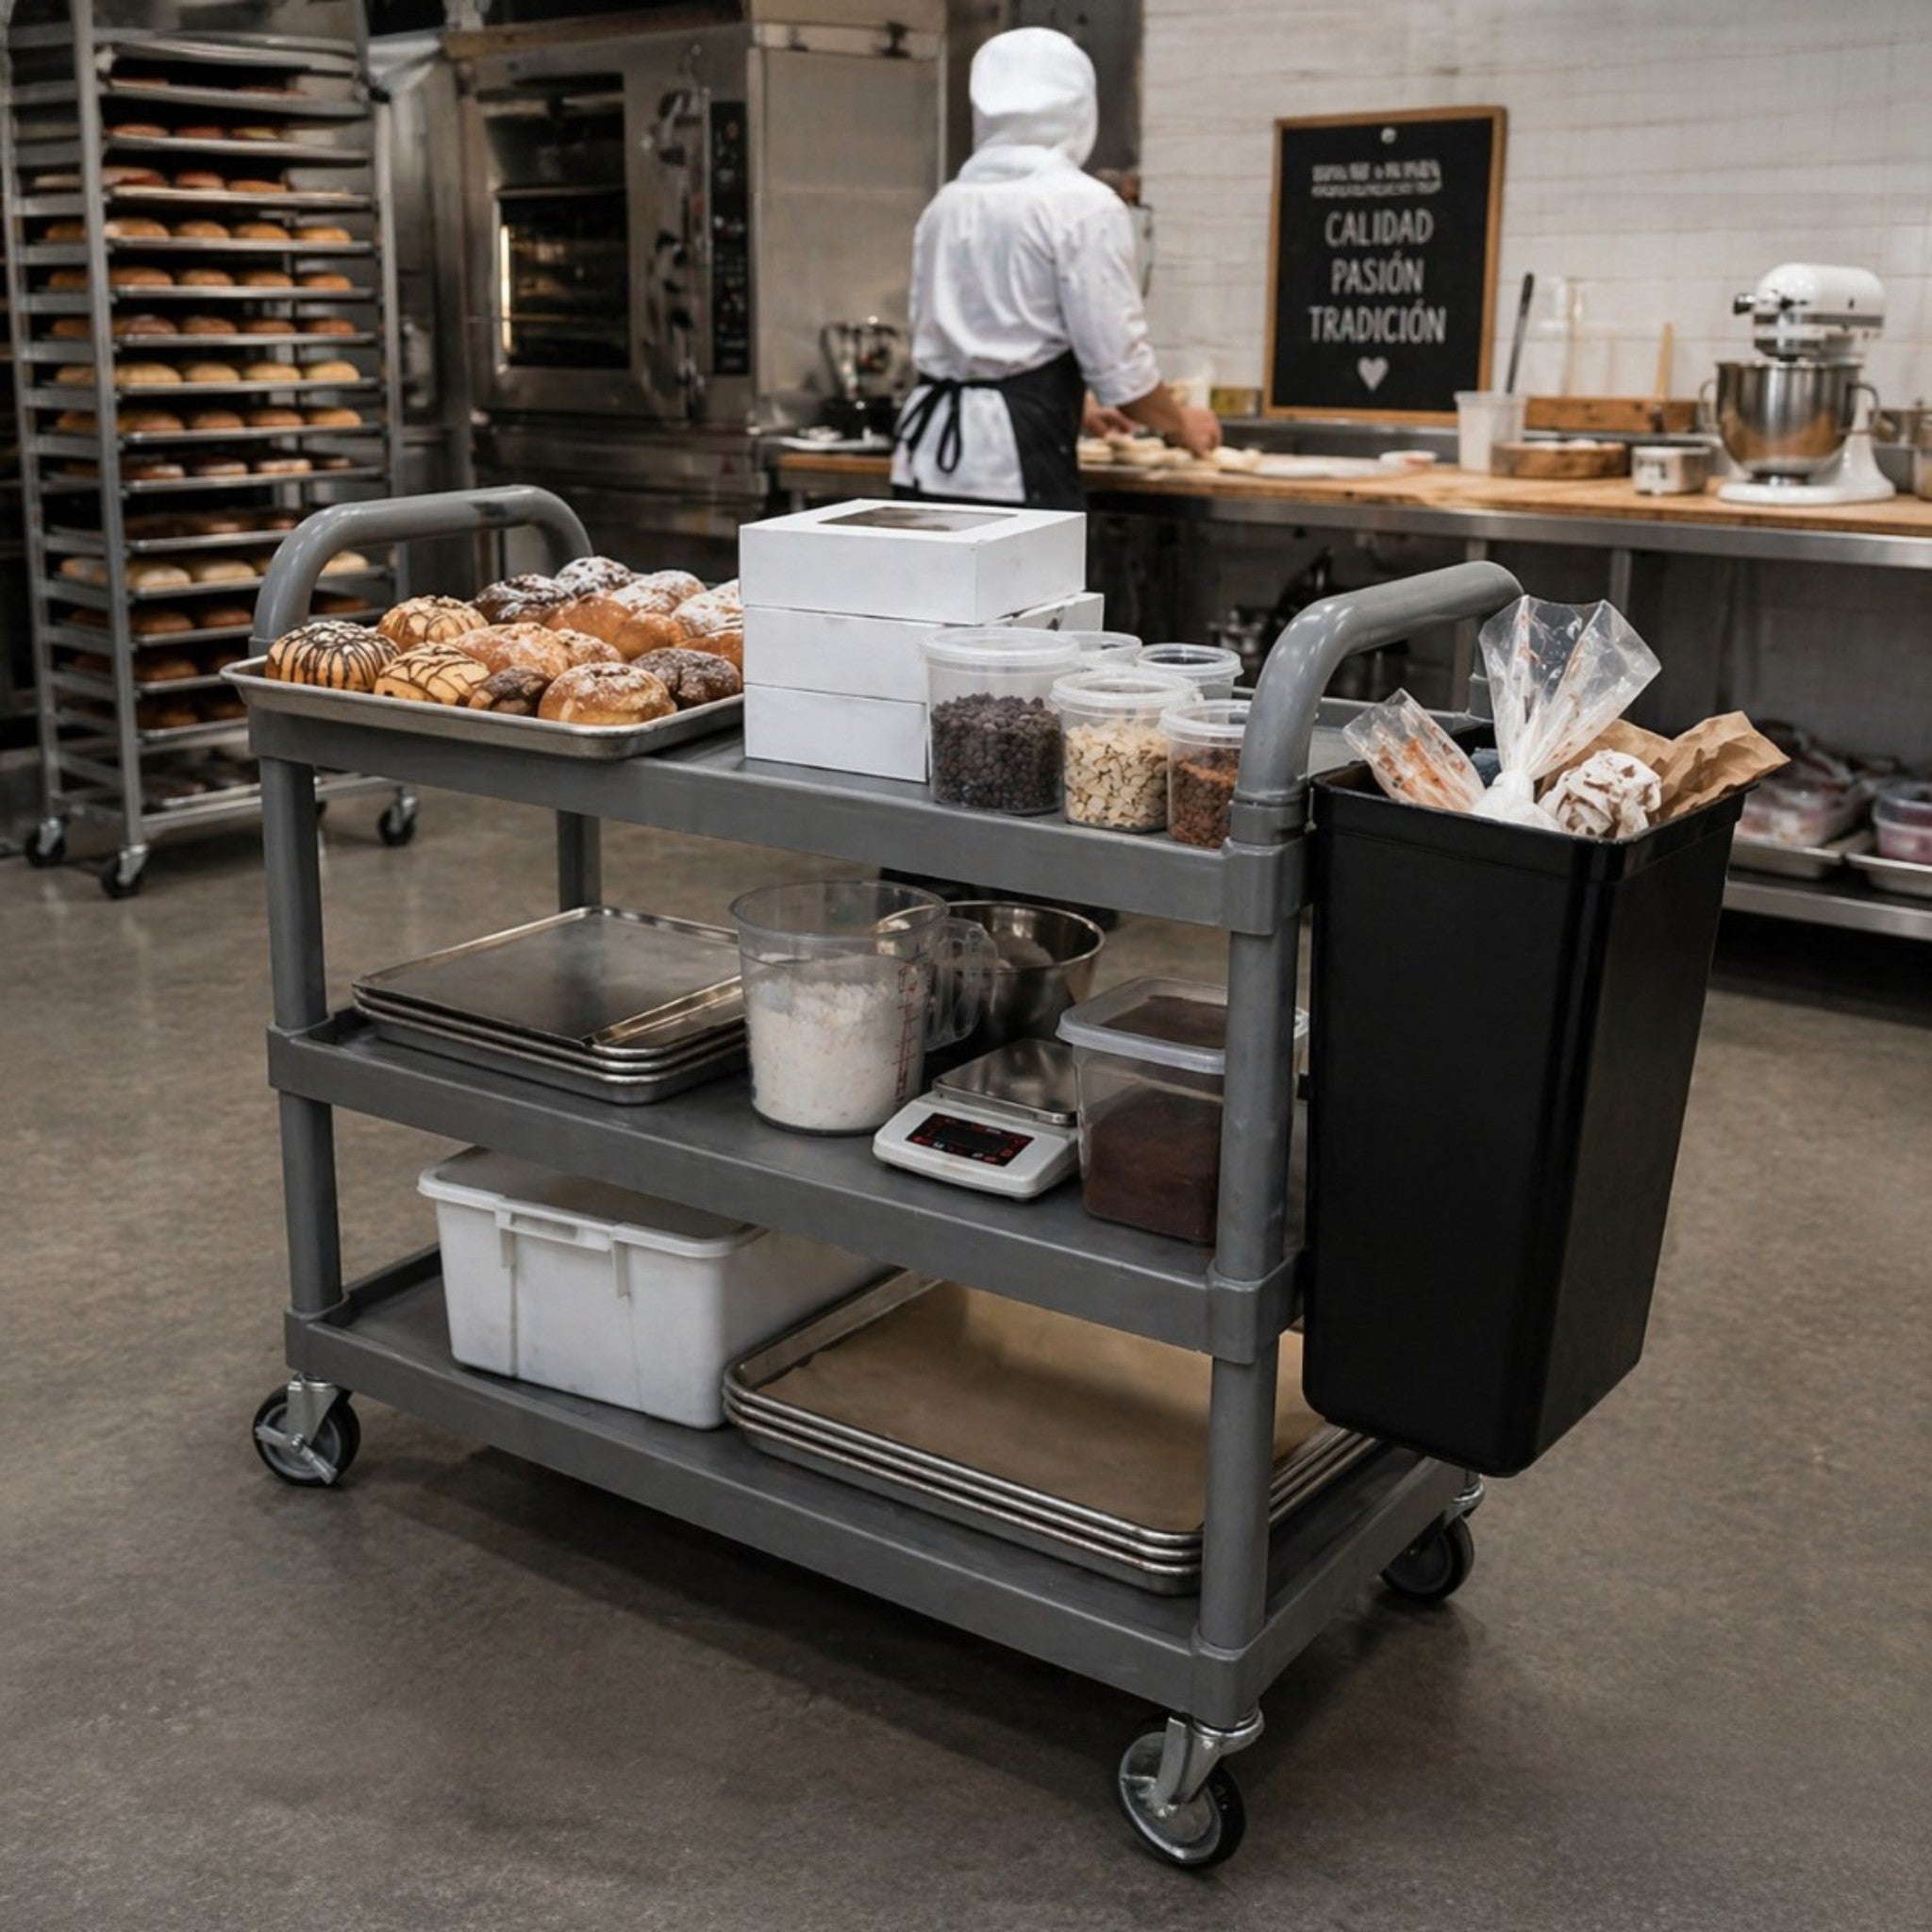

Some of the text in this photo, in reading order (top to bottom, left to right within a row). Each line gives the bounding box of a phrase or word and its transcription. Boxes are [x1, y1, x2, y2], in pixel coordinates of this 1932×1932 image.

[1324, 208, 1434, 246] CALIDAD
[1331, 251, 1424, 294] PASIÓN
[1308, 300, 1446, 343] TRADICIÓN
